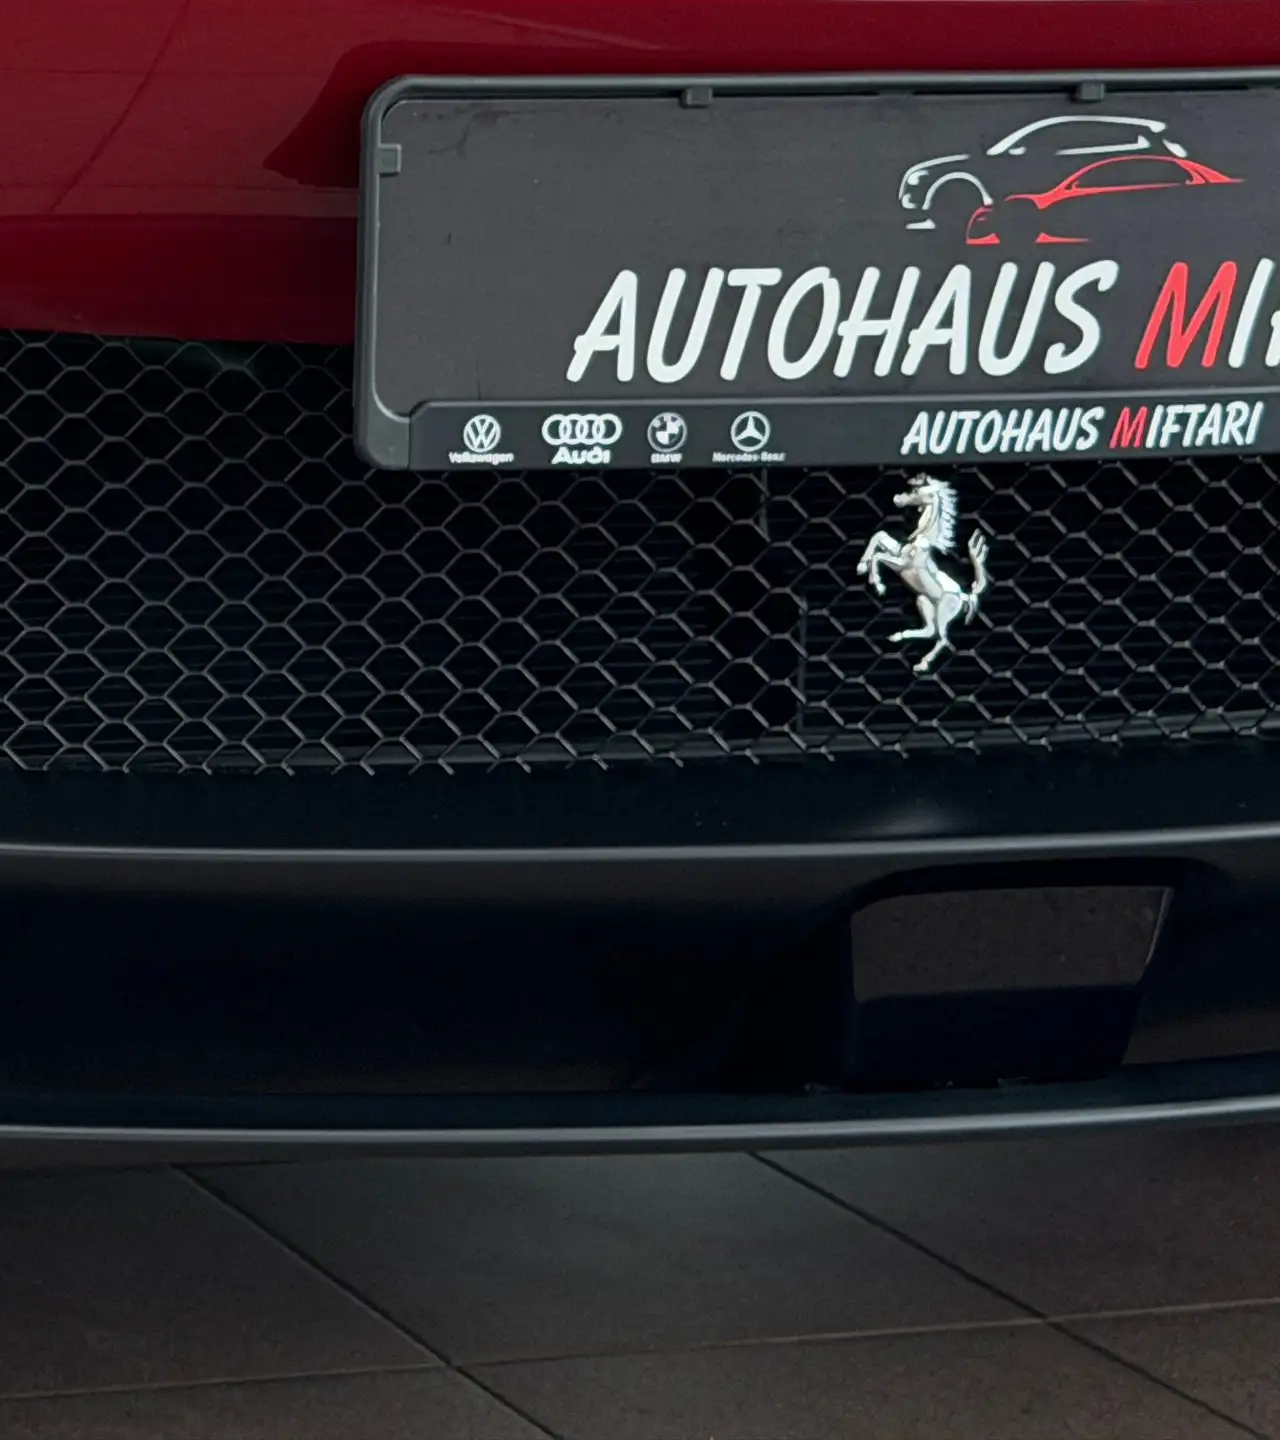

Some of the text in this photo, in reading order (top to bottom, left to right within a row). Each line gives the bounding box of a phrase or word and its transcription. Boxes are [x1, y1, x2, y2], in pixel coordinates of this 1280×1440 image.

[566, 257, 1280, 384] AUTOHAUS MI
[900, 400, 1265, 456] AUTOHAUS MIFTARI
[551, 446, 612, 465] Audi
[650, 452, 683, 464] BMW
